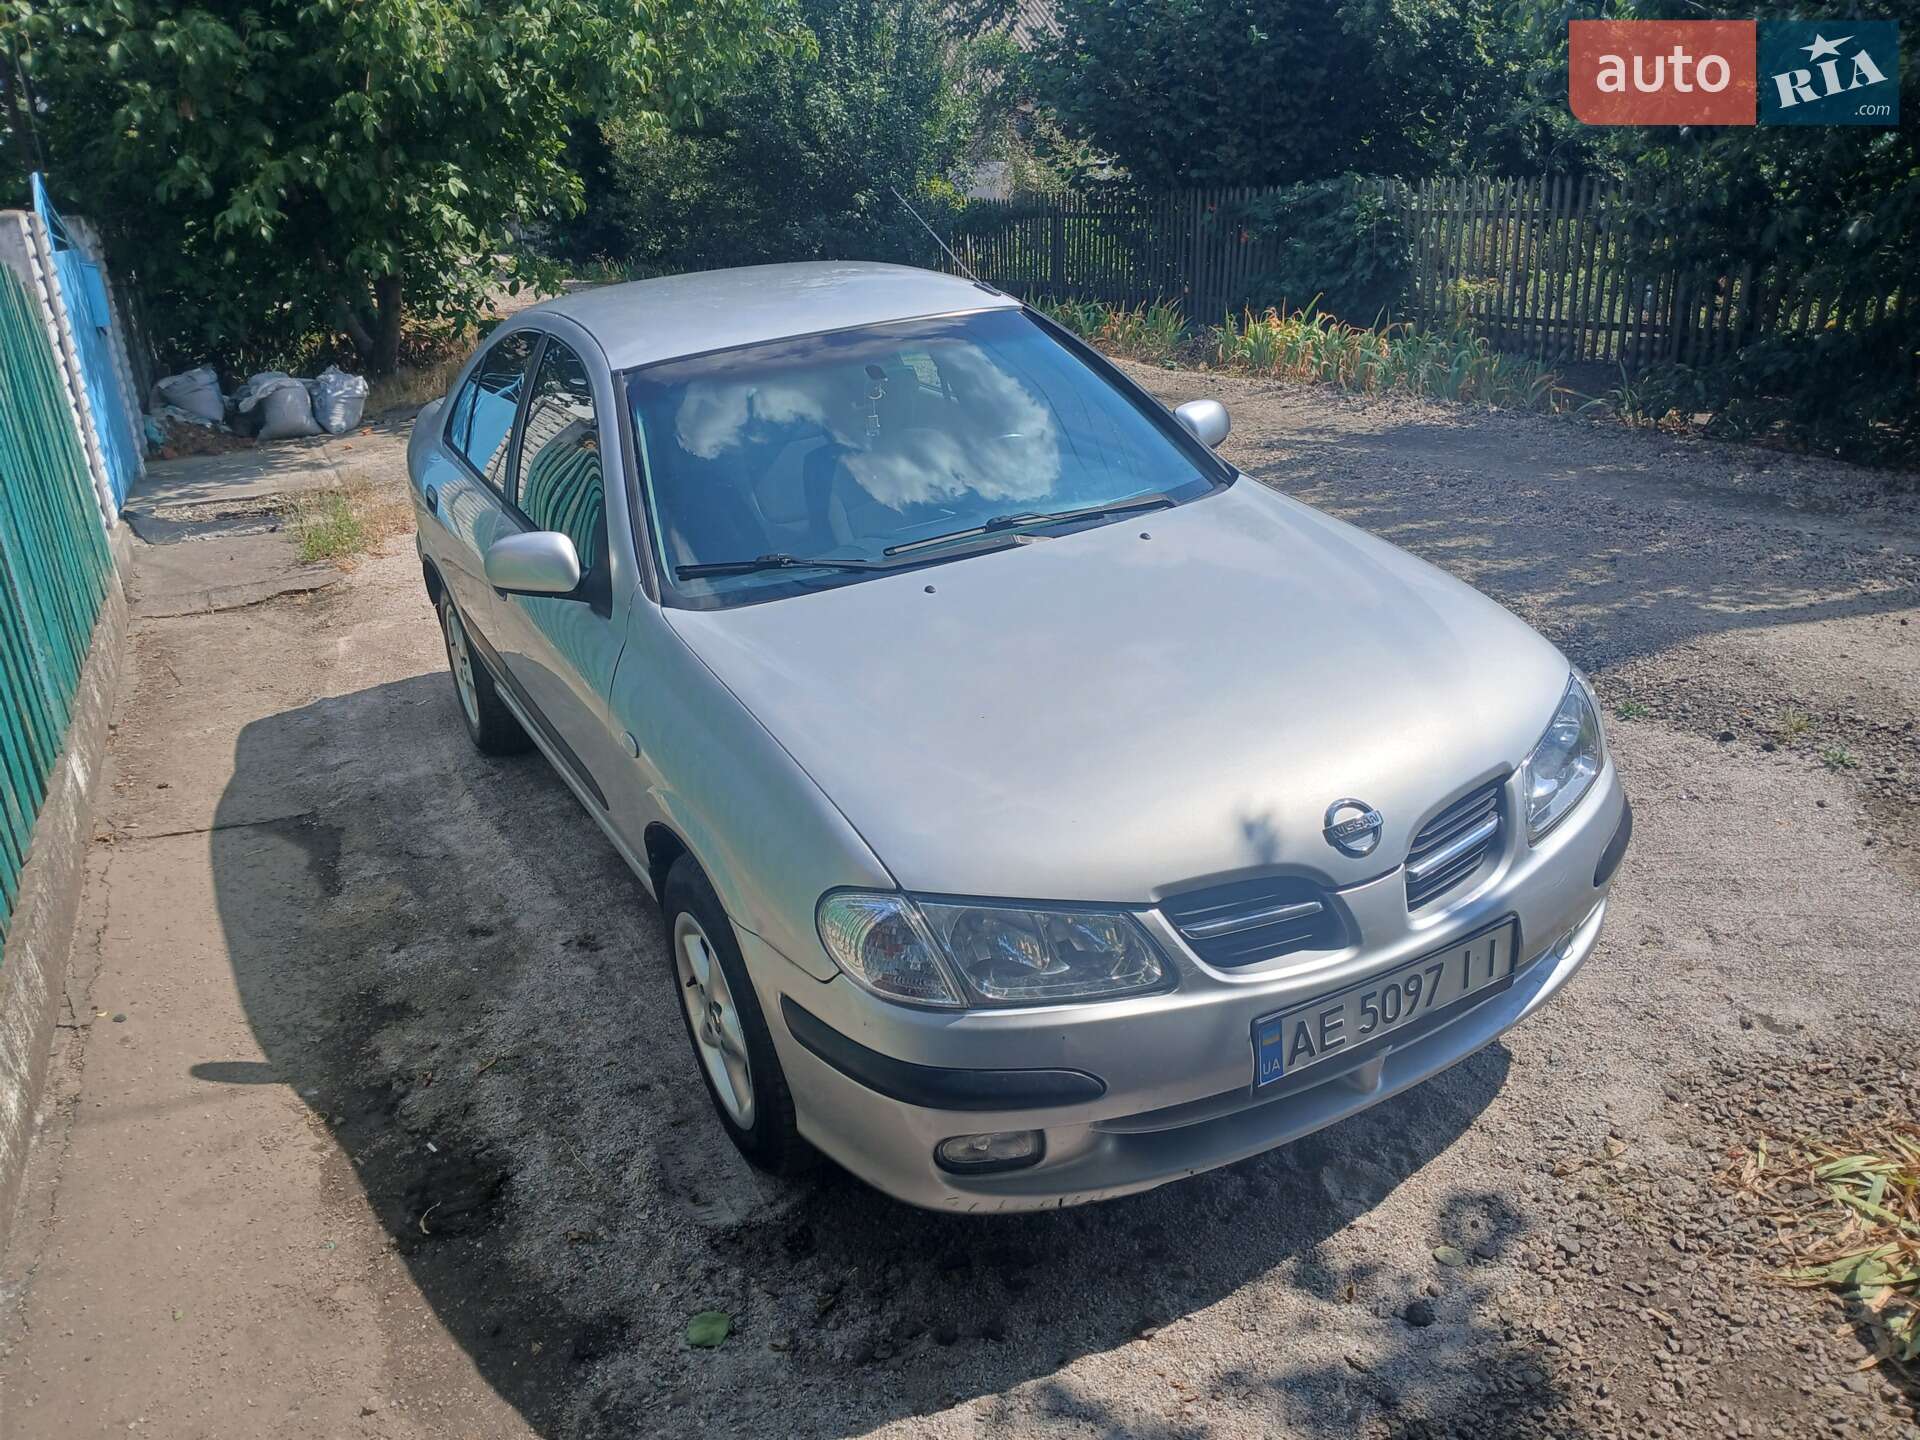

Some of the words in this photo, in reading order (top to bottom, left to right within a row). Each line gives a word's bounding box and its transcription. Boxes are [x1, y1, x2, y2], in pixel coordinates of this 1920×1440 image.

[1333, 813, 1380, 838] NISSAN
[1287, 1003, 1347, 1067] AE
[1359, 961, 1445, 1034] 5097
[1262, 1060, 1281, 1076] UA
